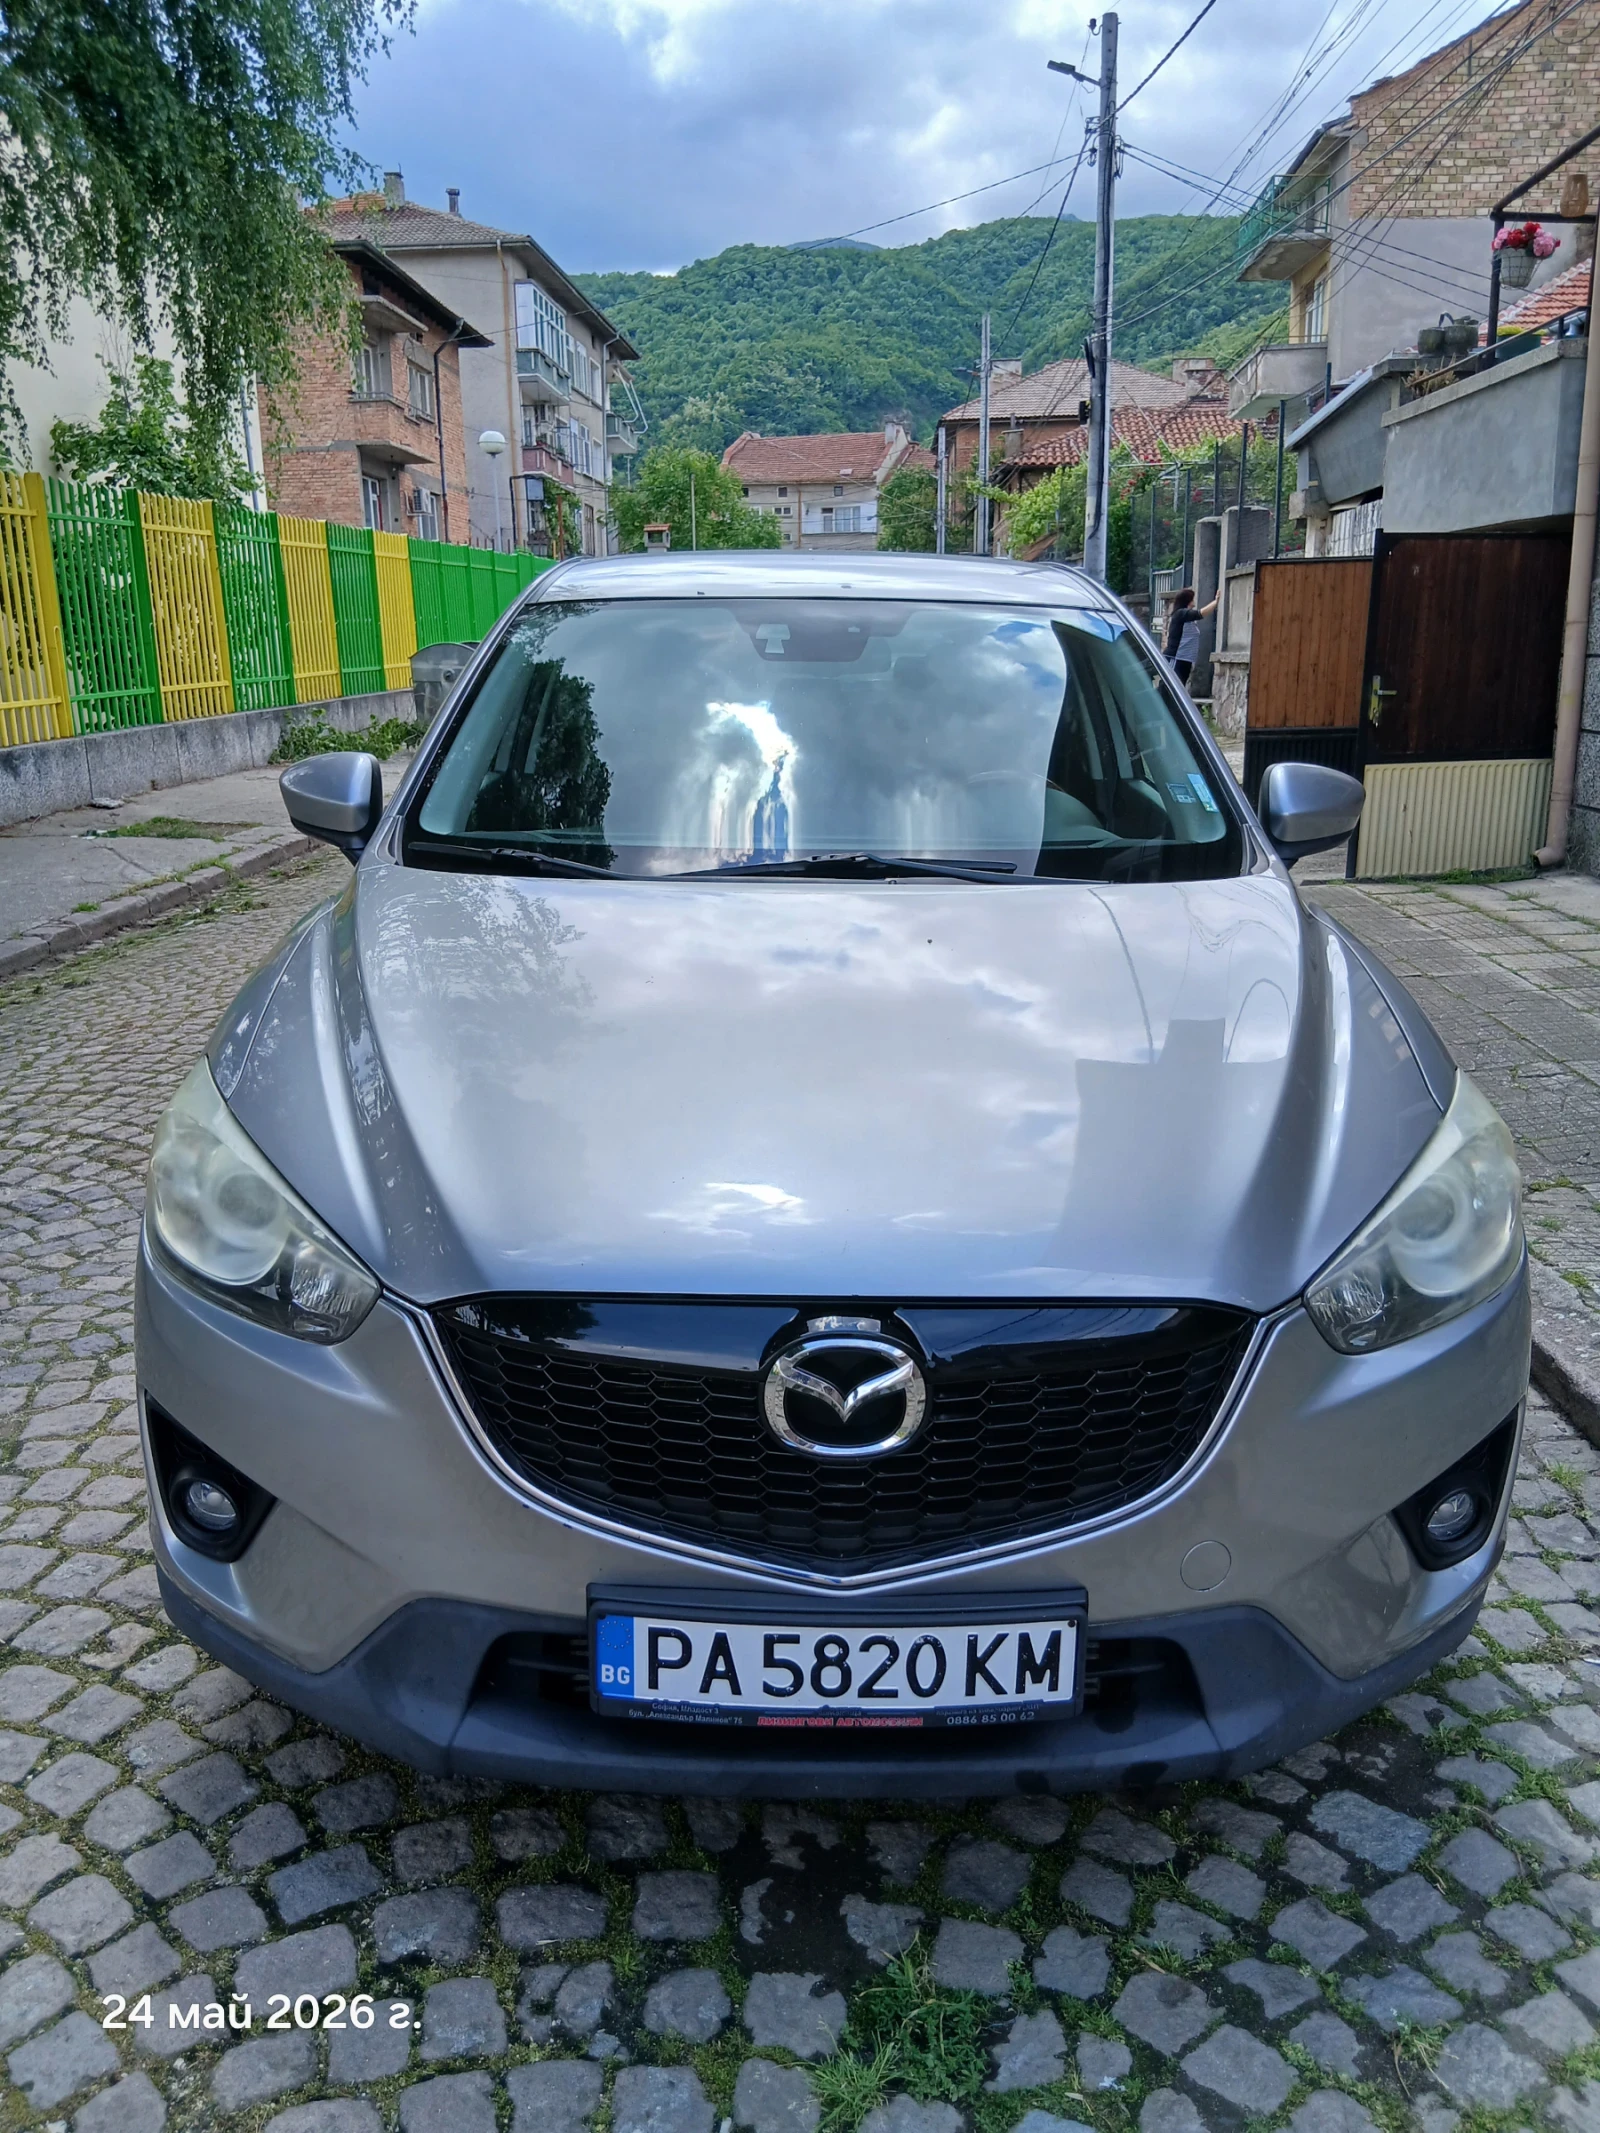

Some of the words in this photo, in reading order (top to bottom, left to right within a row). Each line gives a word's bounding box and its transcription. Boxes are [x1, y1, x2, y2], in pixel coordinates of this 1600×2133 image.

[648, 1626, 742, 1695] PA
[763, 1634, 947, 1698] 5820
[965, 1630, 1062, 1696] KM
[601, 1664, 631, 1684] BG
[628, 1709, 644, 1718] бул.
[946, 1716, 977, 1725] 0886
[981, 1714, 997, 1723] 85
[1000, 1712, 1016, 1722] 00
[1020, 1711, 1035, 1721] 62
[757, 1716, 833, 1726] ЛИЗИНГОВИ
[836, 1717, 923, 1727] АВТОМОБИЛИ
